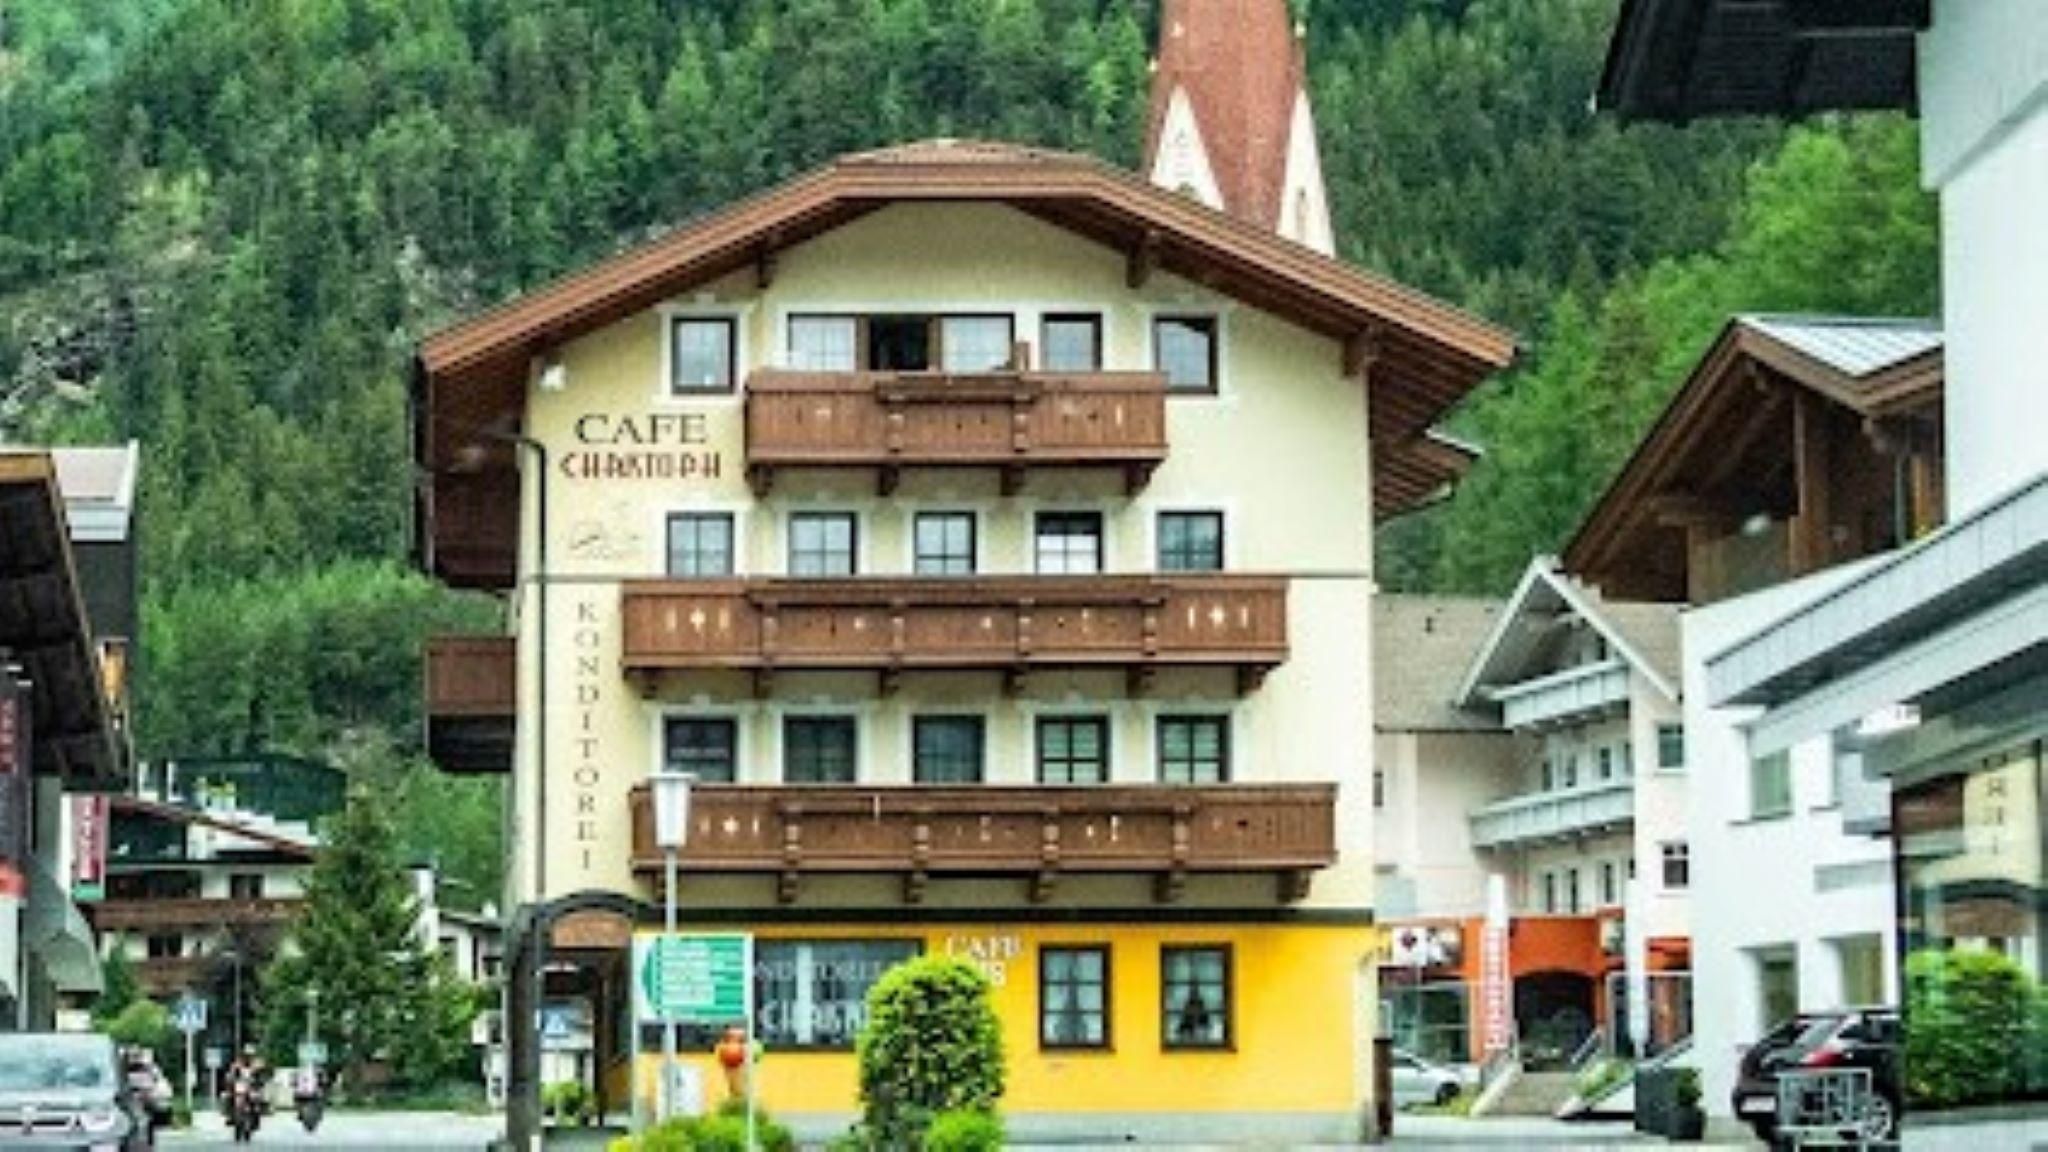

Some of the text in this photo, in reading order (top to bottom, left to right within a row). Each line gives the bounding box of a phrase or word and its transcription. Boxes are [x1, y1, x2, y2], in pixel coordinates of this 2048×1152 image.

[574, 413, 708, 444] CAFE
[573, 601, 600, 871] KONDITOREI
[946, 935, 1023, 959] CAFE
